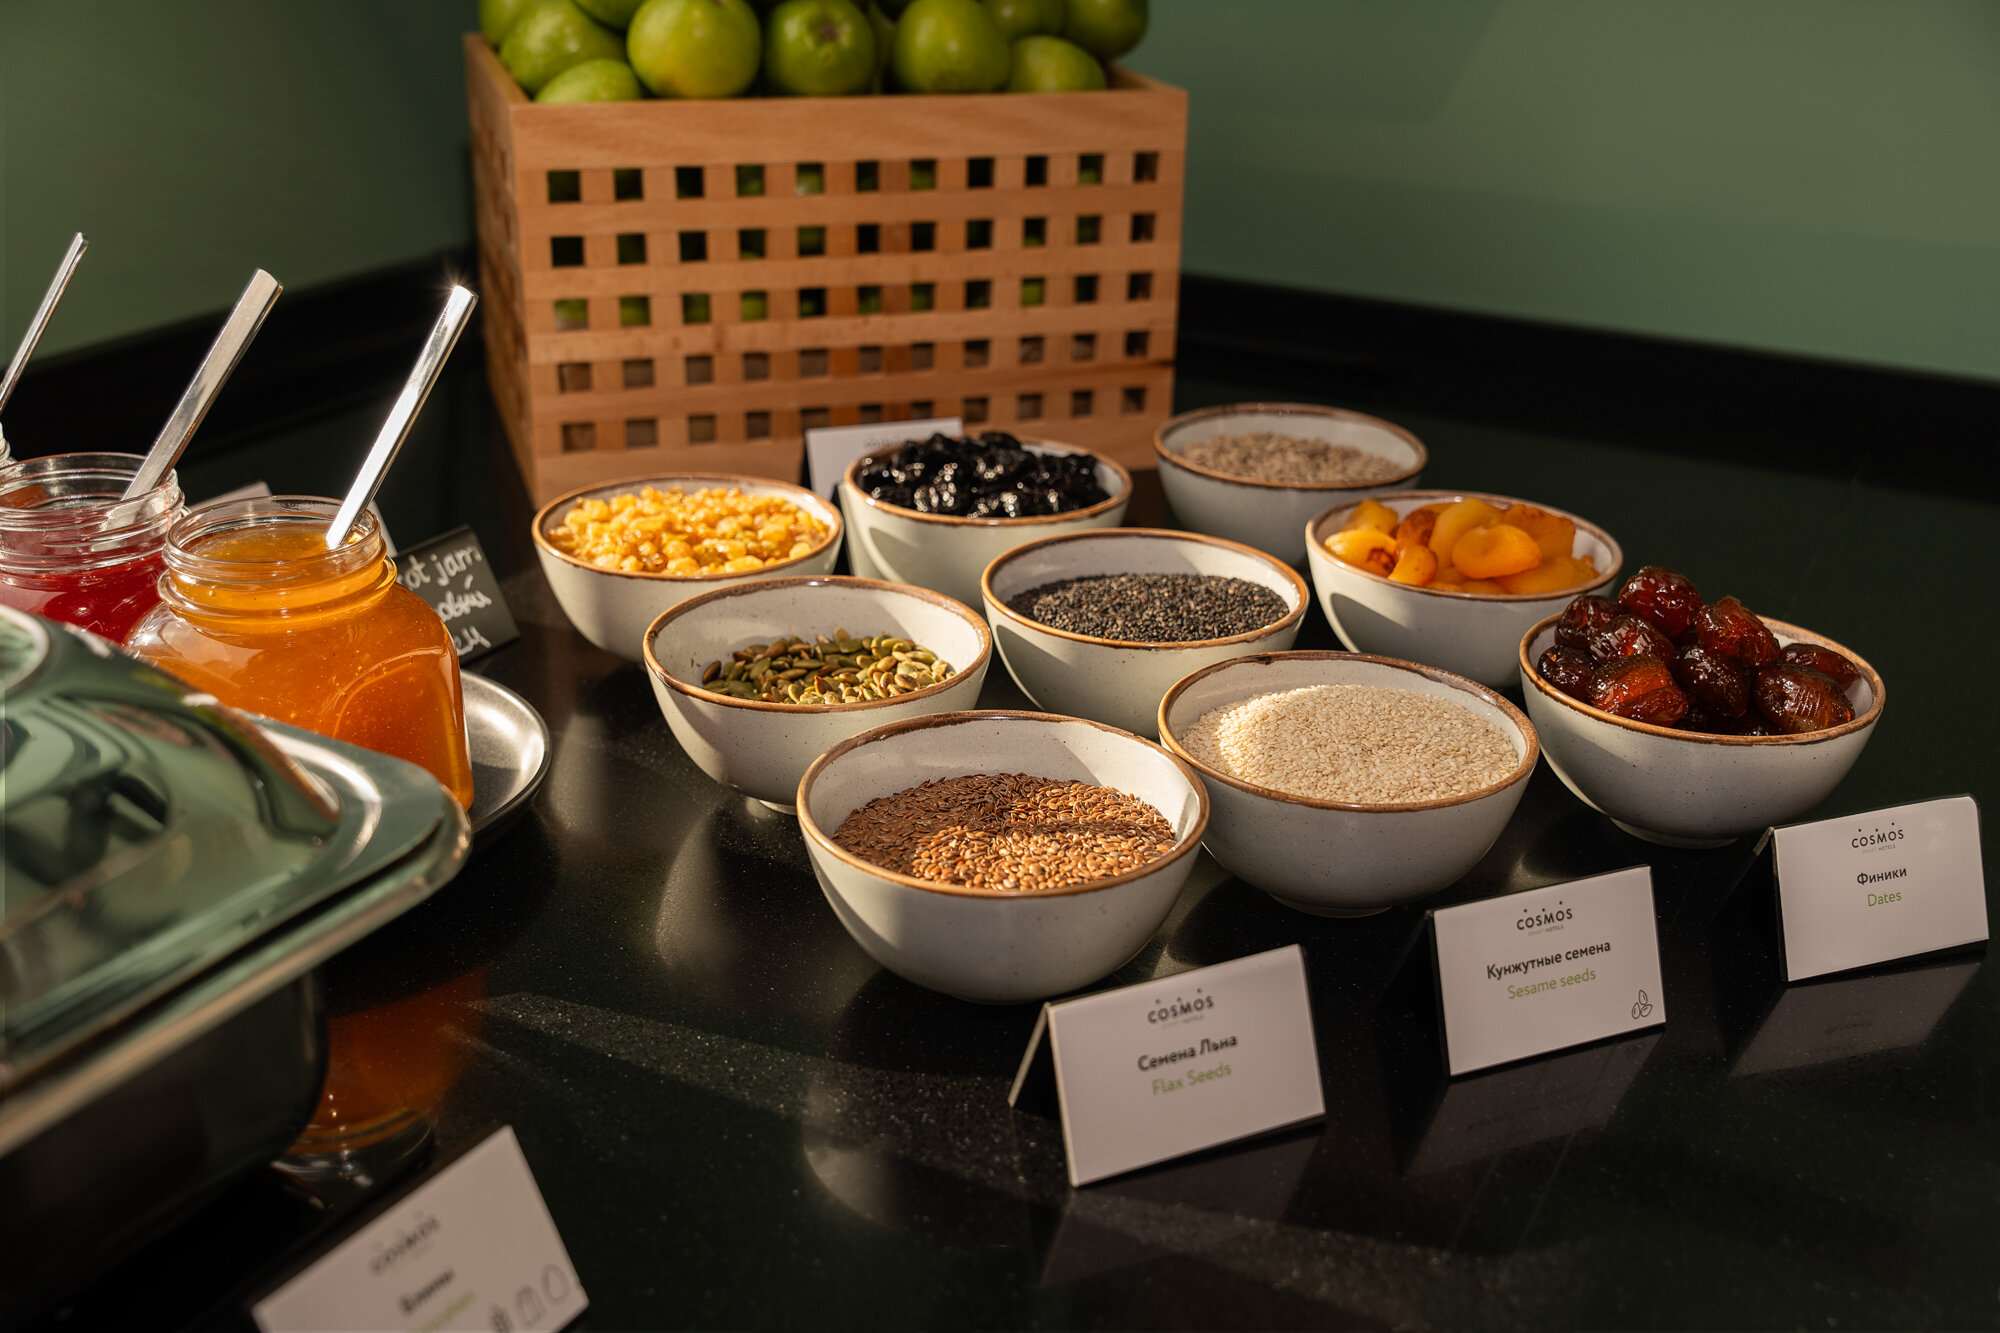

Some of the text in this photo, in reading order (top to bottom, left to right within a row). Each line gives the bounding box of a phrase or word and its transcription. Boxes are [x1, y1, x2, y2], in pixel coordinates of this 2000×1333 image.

[430, 546, 482, 587] jam
[1851, 827, 1904, 848] COSMOS
[1857, 868, 1907, 885] Финики
[1867, 892, 1902, 907] Dates
[1516, 906, 1573, 930] COSMOS
[1486, 941, 1611, 980] Кунжутные семена
[1507, 967, 1597, 1000] Sesame seeds
[1147, 992, 1215, 1024] COSMOS
[1137, 1035, 1238, 1072] Семена Льна
[1151, 1061, 1233, 1097] Flax Seeds
